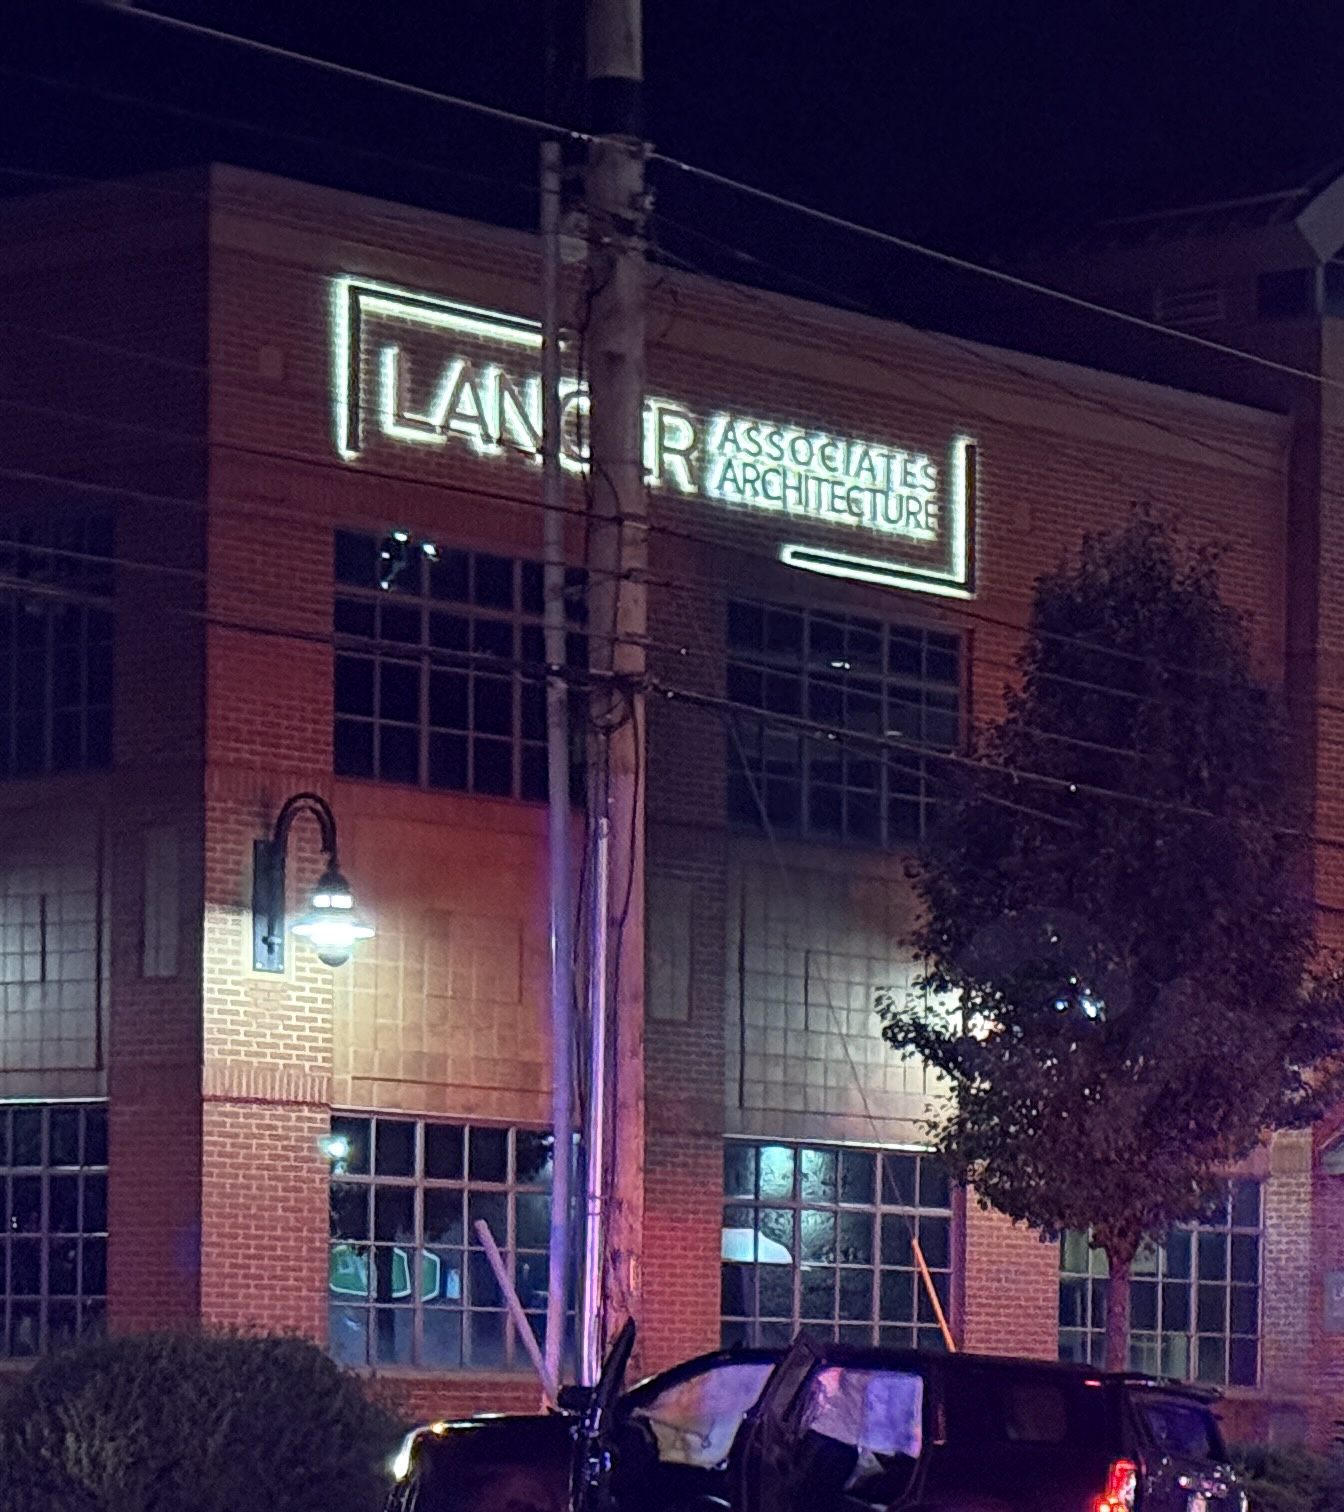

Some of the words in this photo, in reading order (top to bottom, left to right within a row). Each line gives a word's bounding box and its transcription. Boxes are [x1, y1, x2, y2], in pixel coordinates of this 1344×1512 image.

[381, 345, 700, 493] LANCR
[716, 417, 938, 492] ASSOCIATES
[716, 458, 939, 531] ARCHITECTURE
